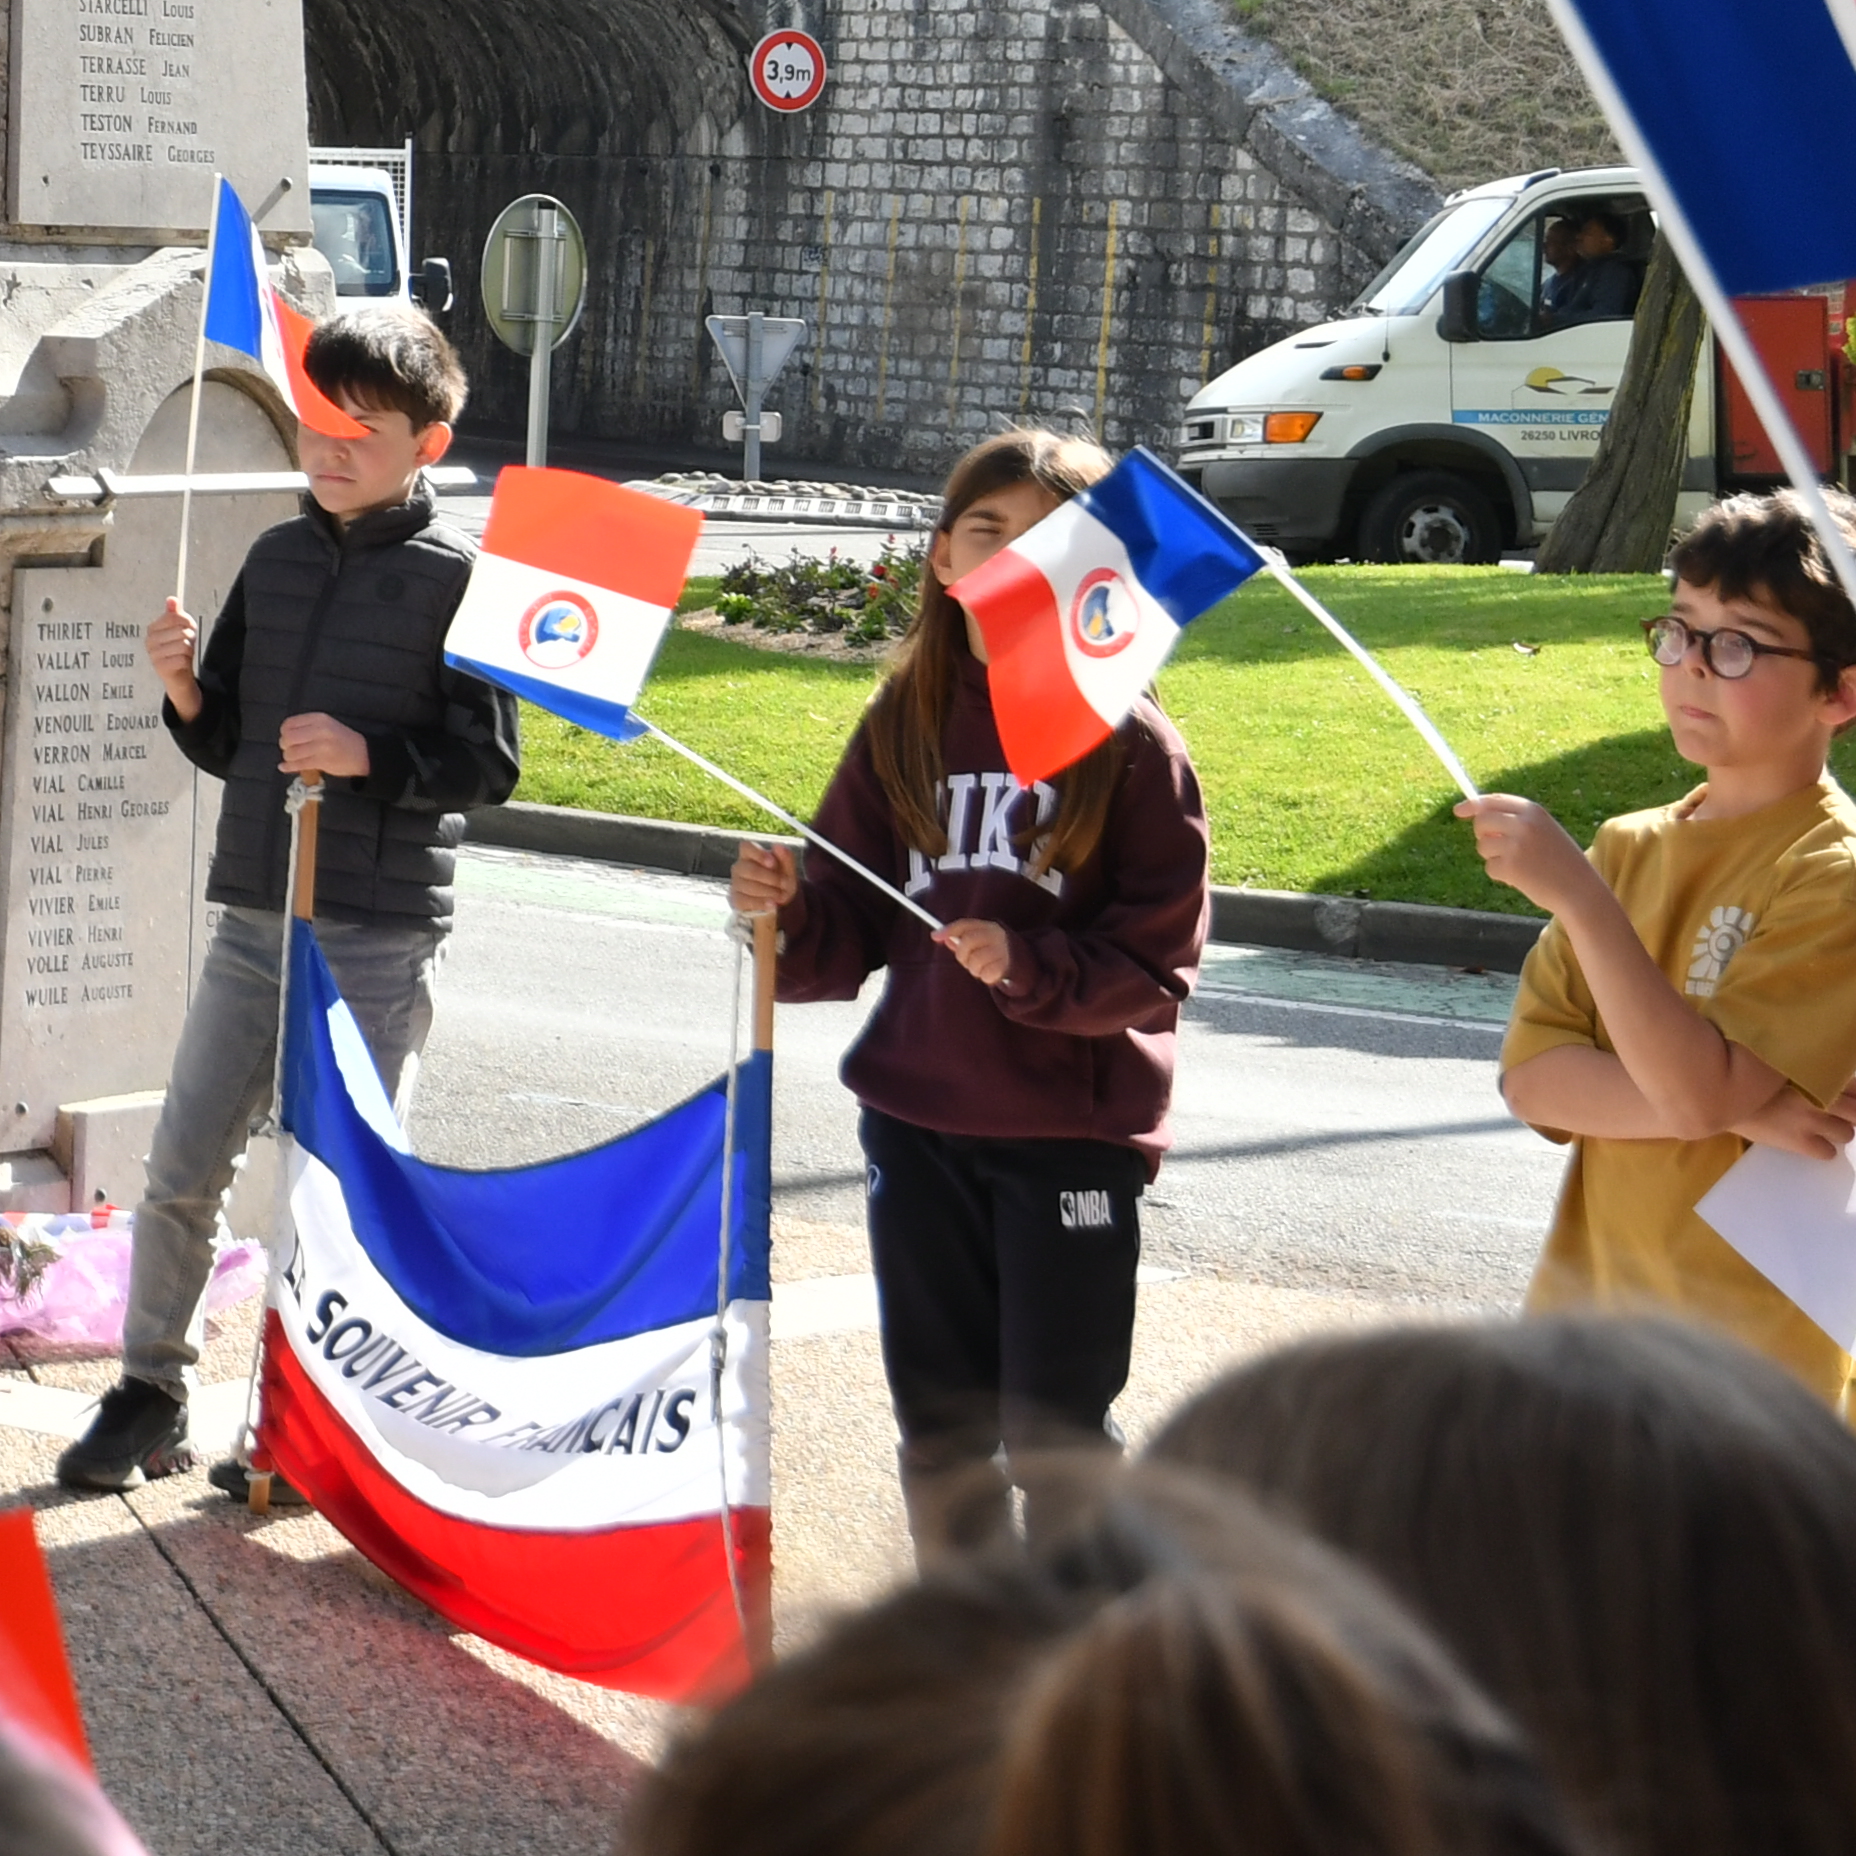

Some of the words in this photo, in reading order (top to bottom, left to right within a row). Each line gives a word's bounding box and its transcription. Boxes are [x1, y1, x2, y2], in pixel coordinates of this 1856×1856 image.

[163, 0, 194, 18] LOUIS
[80, 24, 133, 44] SUBRAN
[150, 29, 194, 47] FELICIEN
[80, 56, 146, 75] TERRASSE
[162, 60, 190, 77] JEAN
[766, 60, 811, 84] 3,9m
[80, 85, 125, 102] TERRU
[140, 87, 171, 105] LOUIS
[80, 114, 132, 132] TESTON
[148, 116, 197, 134] FERNAND
[80, 142, 152, 161] TEYSSAIRE
[168, 146, 214, 163] GEORGES
[1521, 430, 1556, 441] 26250
[38, 622, 92, 641] THIRIET
[106, 622, 140, 638] HENRI
[37, 652, 90, 670] VALLAT
[102, 651, 134, 668] LOUIS
[36, 683, 90, 702] VALLON
[102, 683, 133, 699] EMILE
[35, 715, 94, 734] VENOUIL
[34, 745, 90, 764] VERRON
[103, 743, 147, 762] MARCEL
[33, 775, 65, 794] VIAL
[78, 774, 125, 792] CAMILLE
[32, 804, 64, 823] VIAL
[77, 803, 112, 820] HENRI
[121, 800, 170, 818] GEORGES
[31, 835, 63, 853] VIAL
[76, 834, 109, 851] JULES
[30, 867, 62, 885] VIAL
[76, 865, 113, 883] PIERRE
[29, 897, 75, 916] VIVIER
[89, 895, 120, 912] EMILE
[28, 928, 74, 947] VIVIER
[88, 925, 122, 943] HENRI
[27, 955, 69, 975] VOLLE
[82, 952, 133, 970] AUGUSTE
[81, 984, 133, 1002] AUGUSTE
[1076, 1189, 1113, 1227] NBA
[305, 1288, 502, 1435] SOUVENIR
